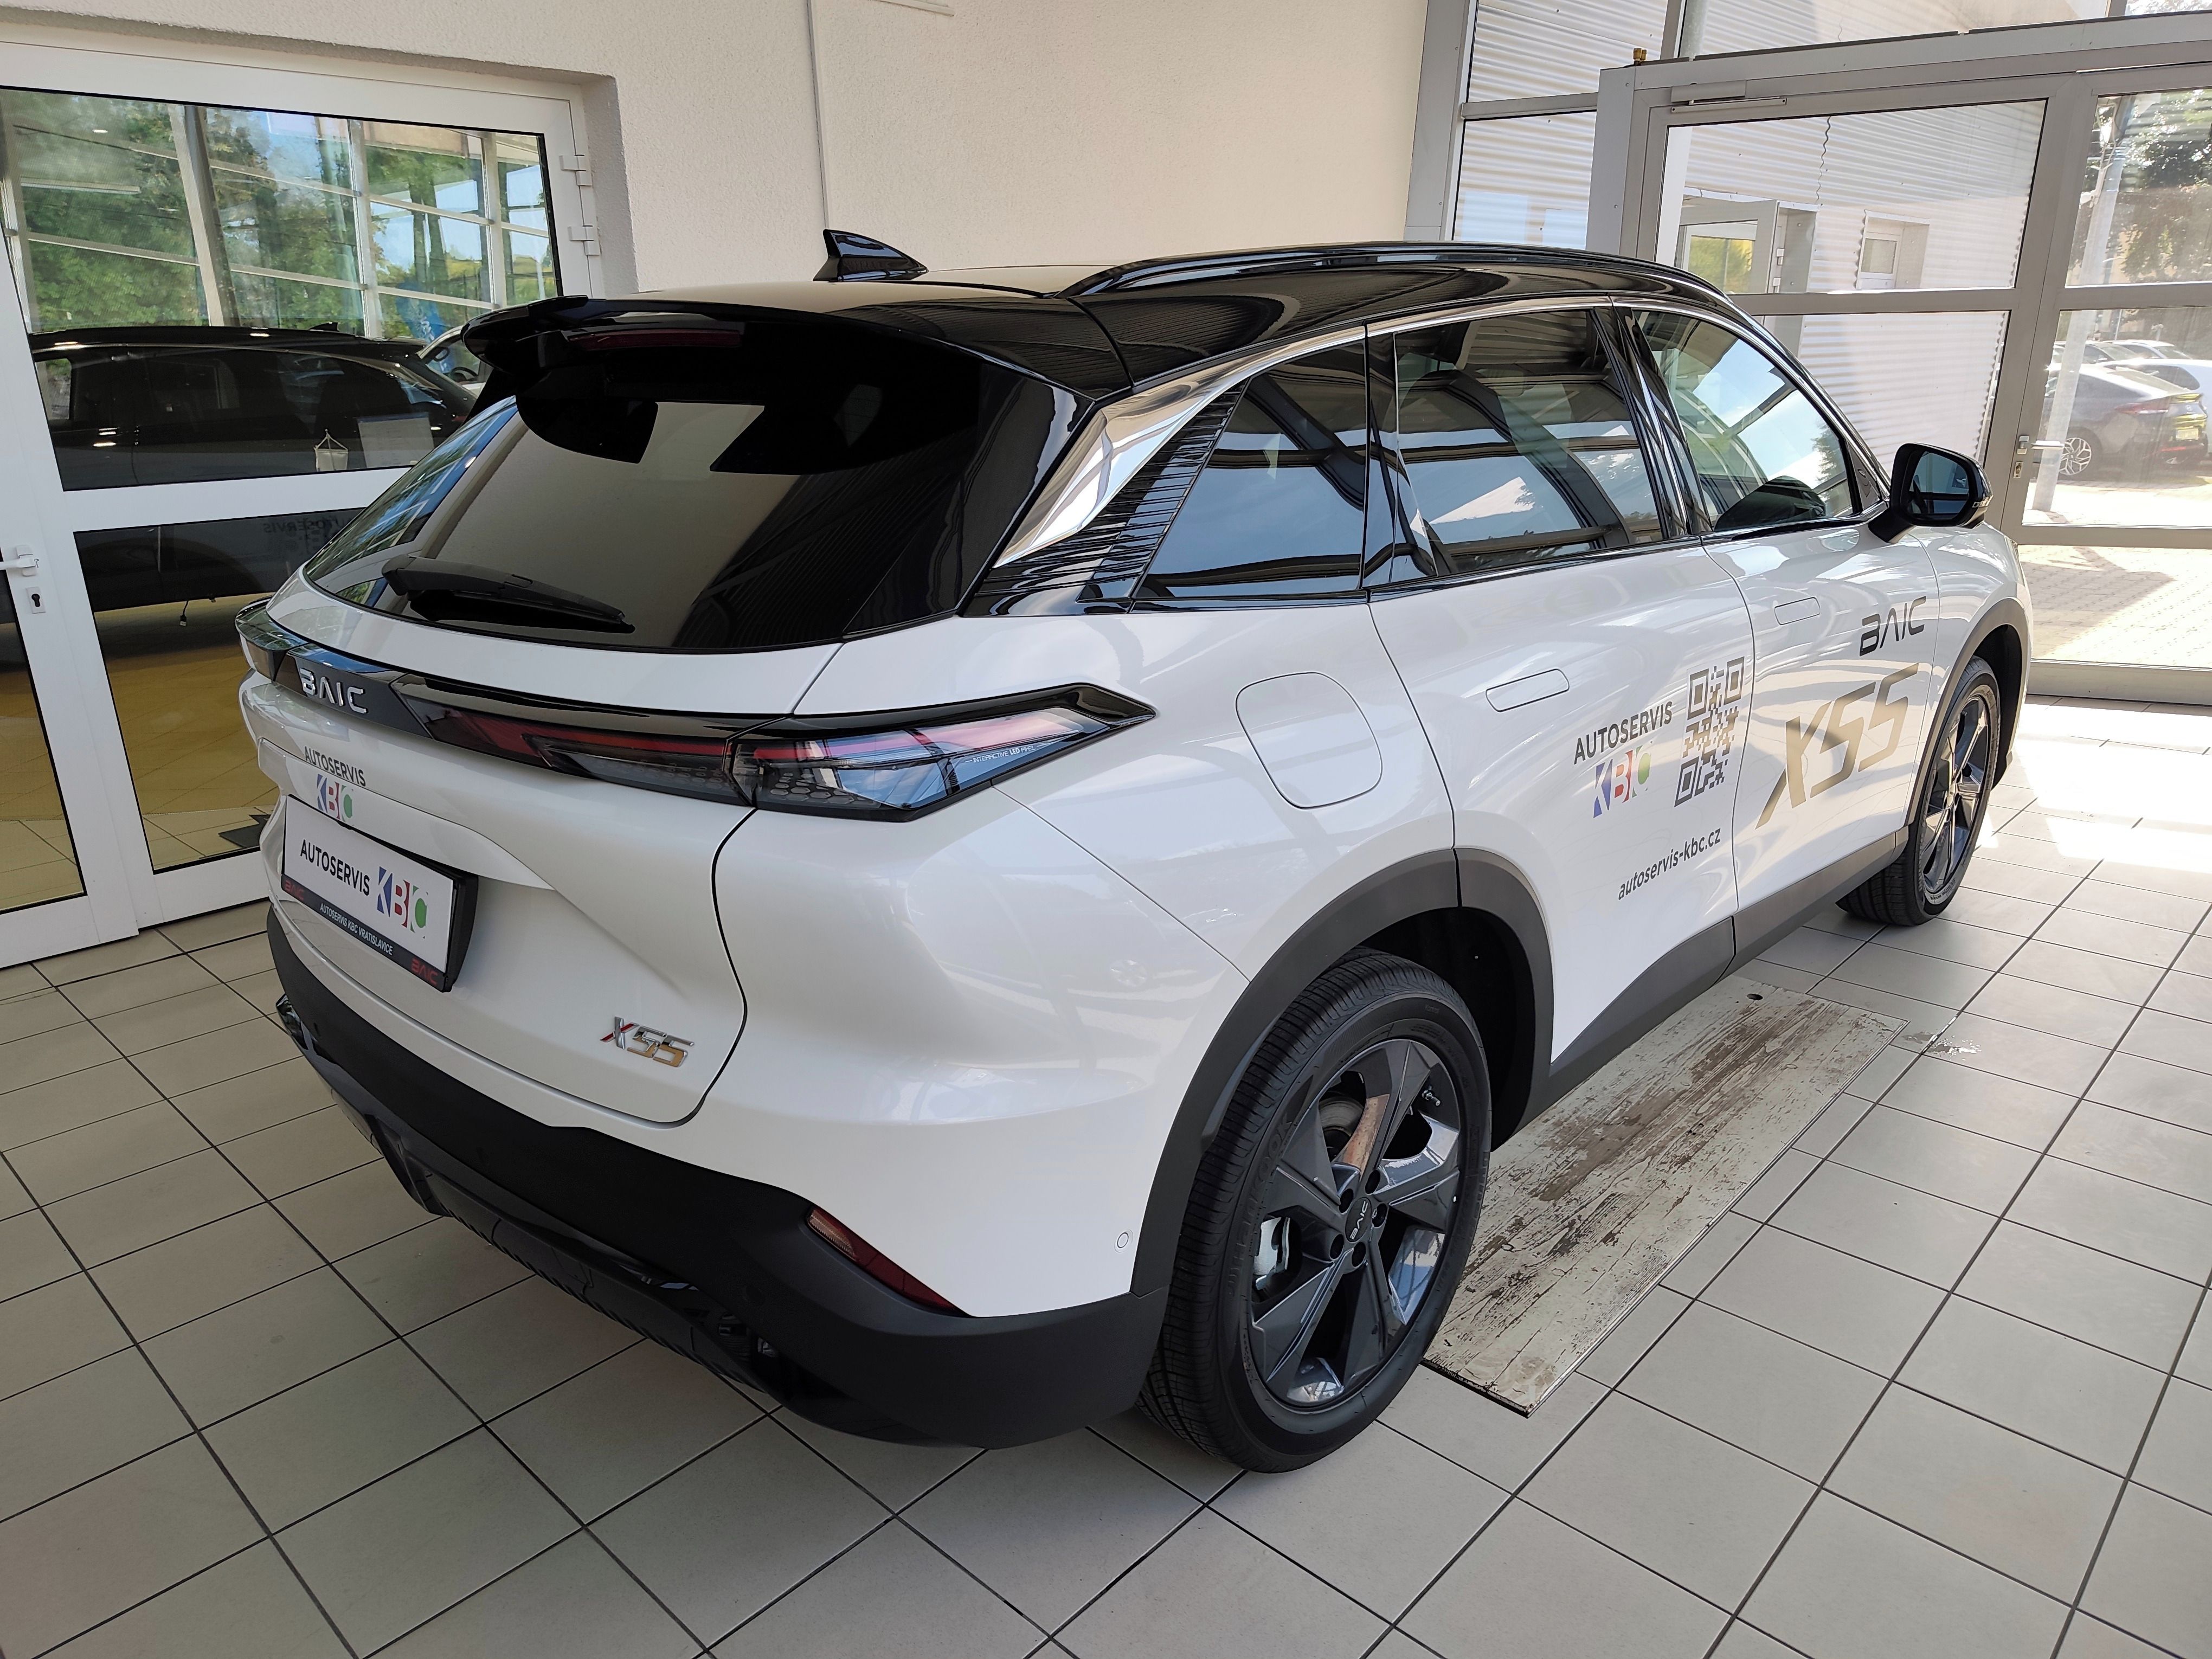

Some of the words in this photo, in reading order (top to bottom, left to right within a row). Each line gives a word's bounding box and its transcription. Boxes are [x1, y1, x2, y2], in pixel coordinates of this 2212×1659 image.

[1859, 596, 1927, 657] BAIC
[299, 667, 368, 714] BAIC
[973, 751, 1009, 763] INTERACTIVE
[1573, 701, 1673, 764] AUTOSERVIS
[1755, 663, 1919, 829] X55
[304, 746, 366, 787] AUTOSERVIS
[300, 839, 371, 896] AUTOSERVIS
[1618, 828, 1721, 901] autoservis-kbc.cz
[319, 903, 348, 927] AUTOSERVIS
[348, 920, 358, 934] KBC
[358, 926, 394, 956] VRATISLAVICE
[410, 957, 439, 986] BAIC
[600, 1016, 695, 1068] X55
[1349, 1200, 1368, 1240] BAIC
